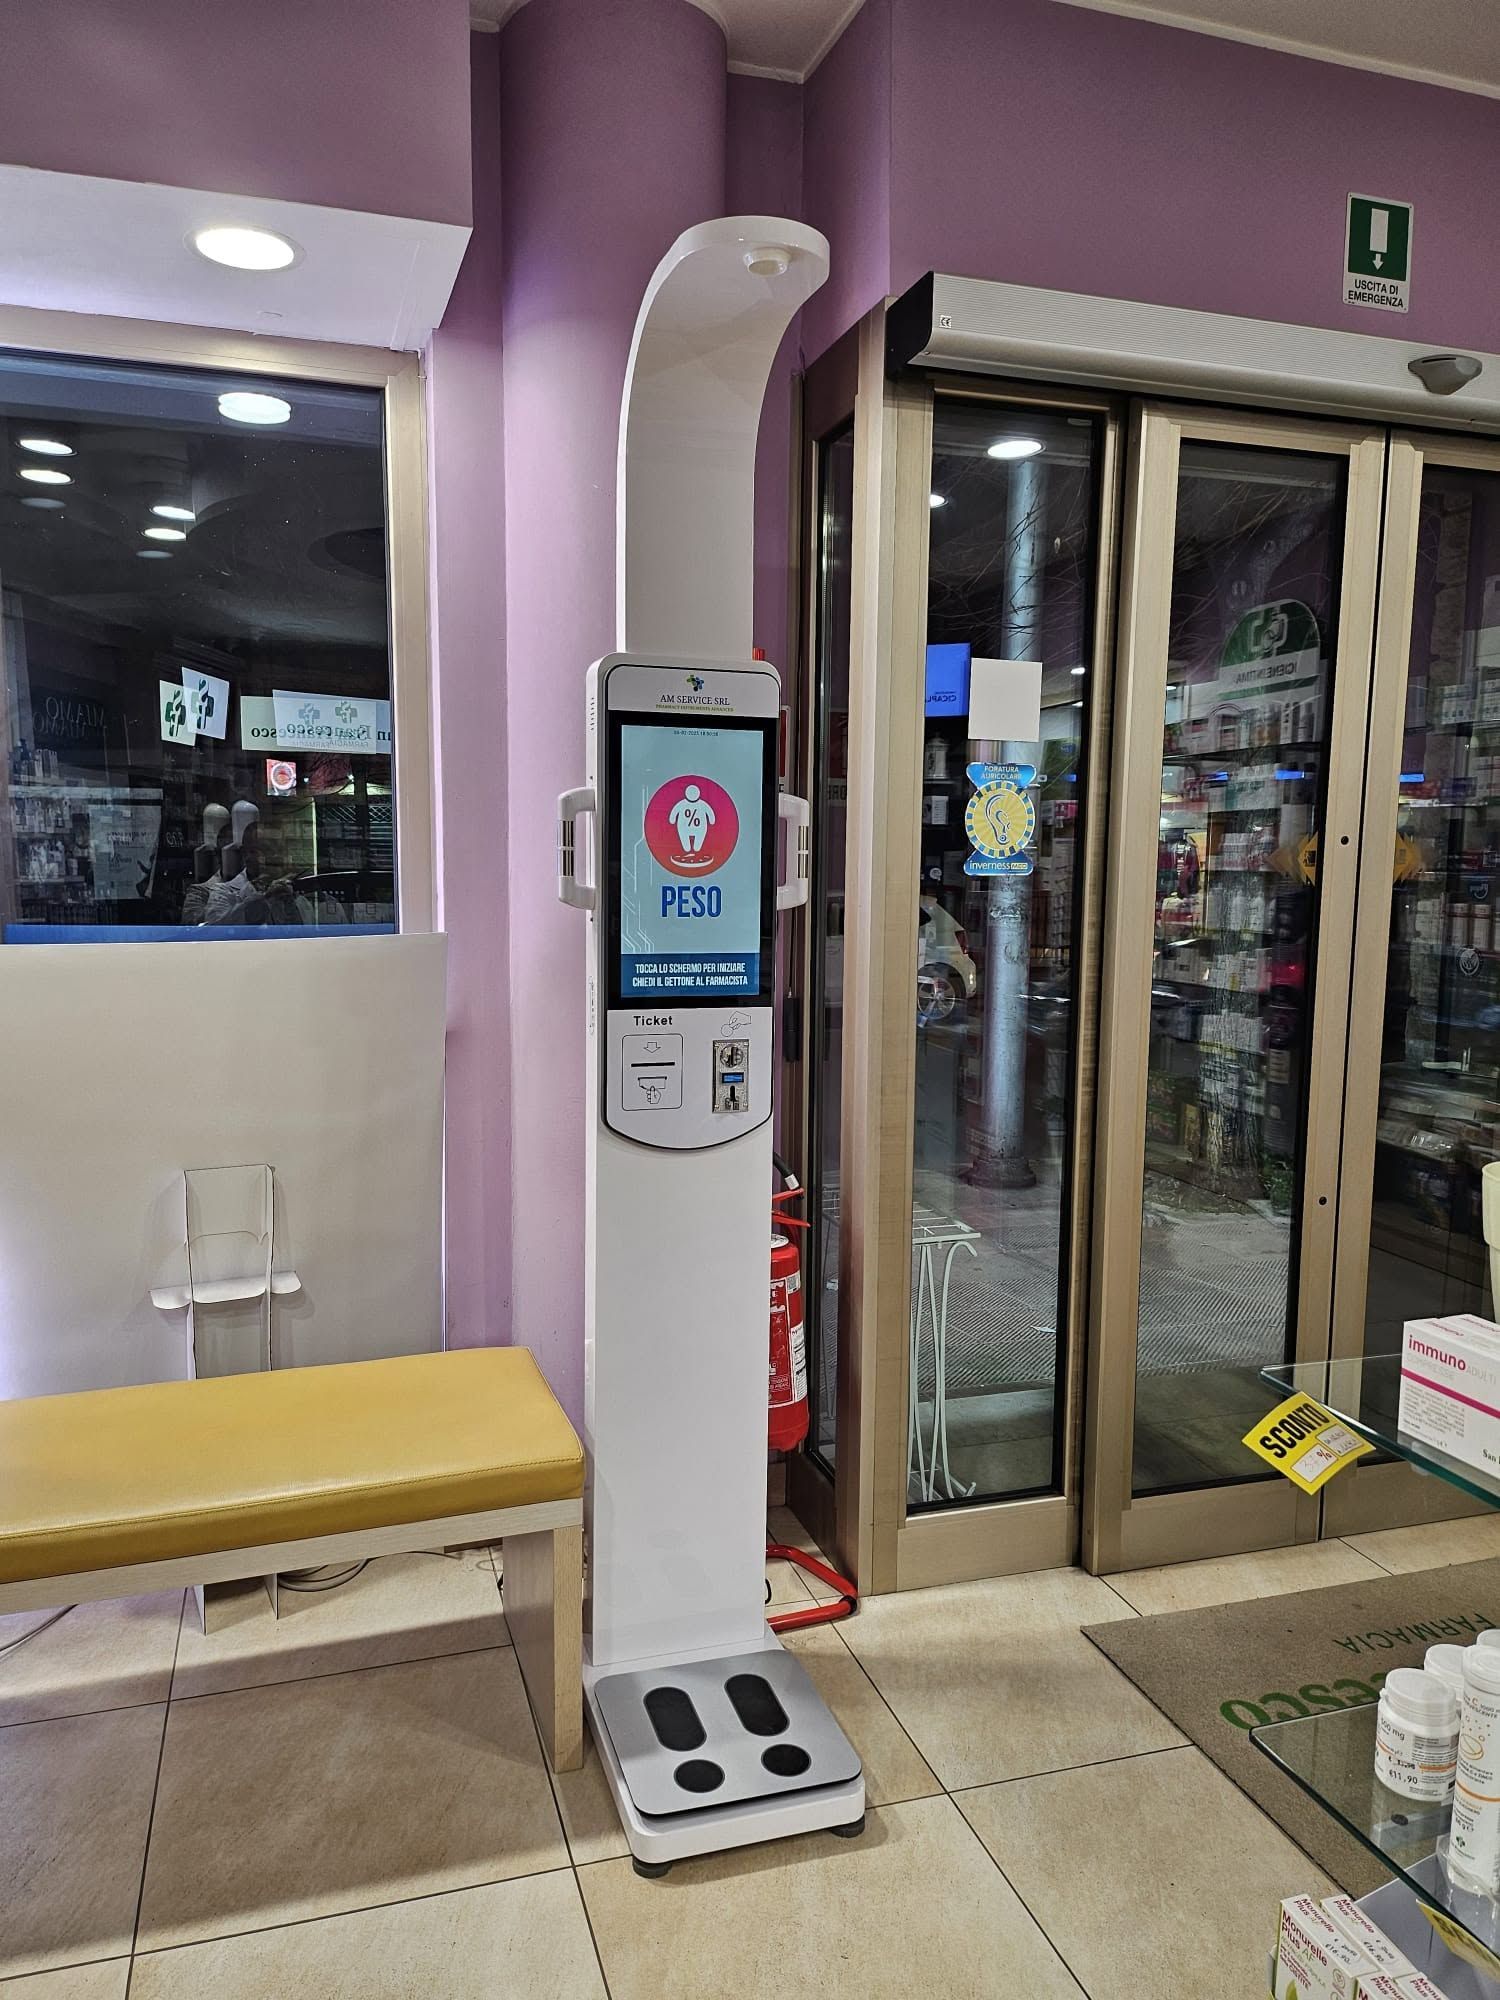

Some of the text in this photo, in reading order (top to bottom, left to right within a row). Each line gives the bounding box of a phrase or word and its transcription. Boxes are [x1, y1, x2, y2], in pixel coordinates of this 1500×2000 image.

[1354, 279, 1399, 296] USCITA DI
[1348, 290, 1404, 308] EMERGENZA
[660, 694, 731, 706] AM SERVICE SRL
[969, 860, 1011, 870] inverness
[661, 885, 722, 918] PESO
[635, 962, 746, 974] TOCCA LO SCHERMO PER INIZIARE
[632, 975, 748, 987] CHIEDI IL GETTONE AL FARMACISTA
[633, 1016, 673, 1026] Ticket
[1409, 1334, 1496, 1385] immuno ADULTI
[1260, 1403, 1330, 1458] SCONTO
[1332, 1613, 1496, 1654] FARMACIA
[1392, 1728, 1405, 1741] mg
[1294, 1900, 1310, 1916] Plus
[1300, 1898, 1335, 1933] Monurelle
[1333, 1900, 1350, 1916] Plus
[1341, 1899, 1375, 1934] Monurelle
[1281, 1921, 1301, 1950] Plus
[1302, 1948, 1317, 1962] AF
[1282, 1909, 1328, 1967] Monurelle
[1370, 1978, 1389, 1996] Plus
[1410, 1979, 1429, 1998] Plus
